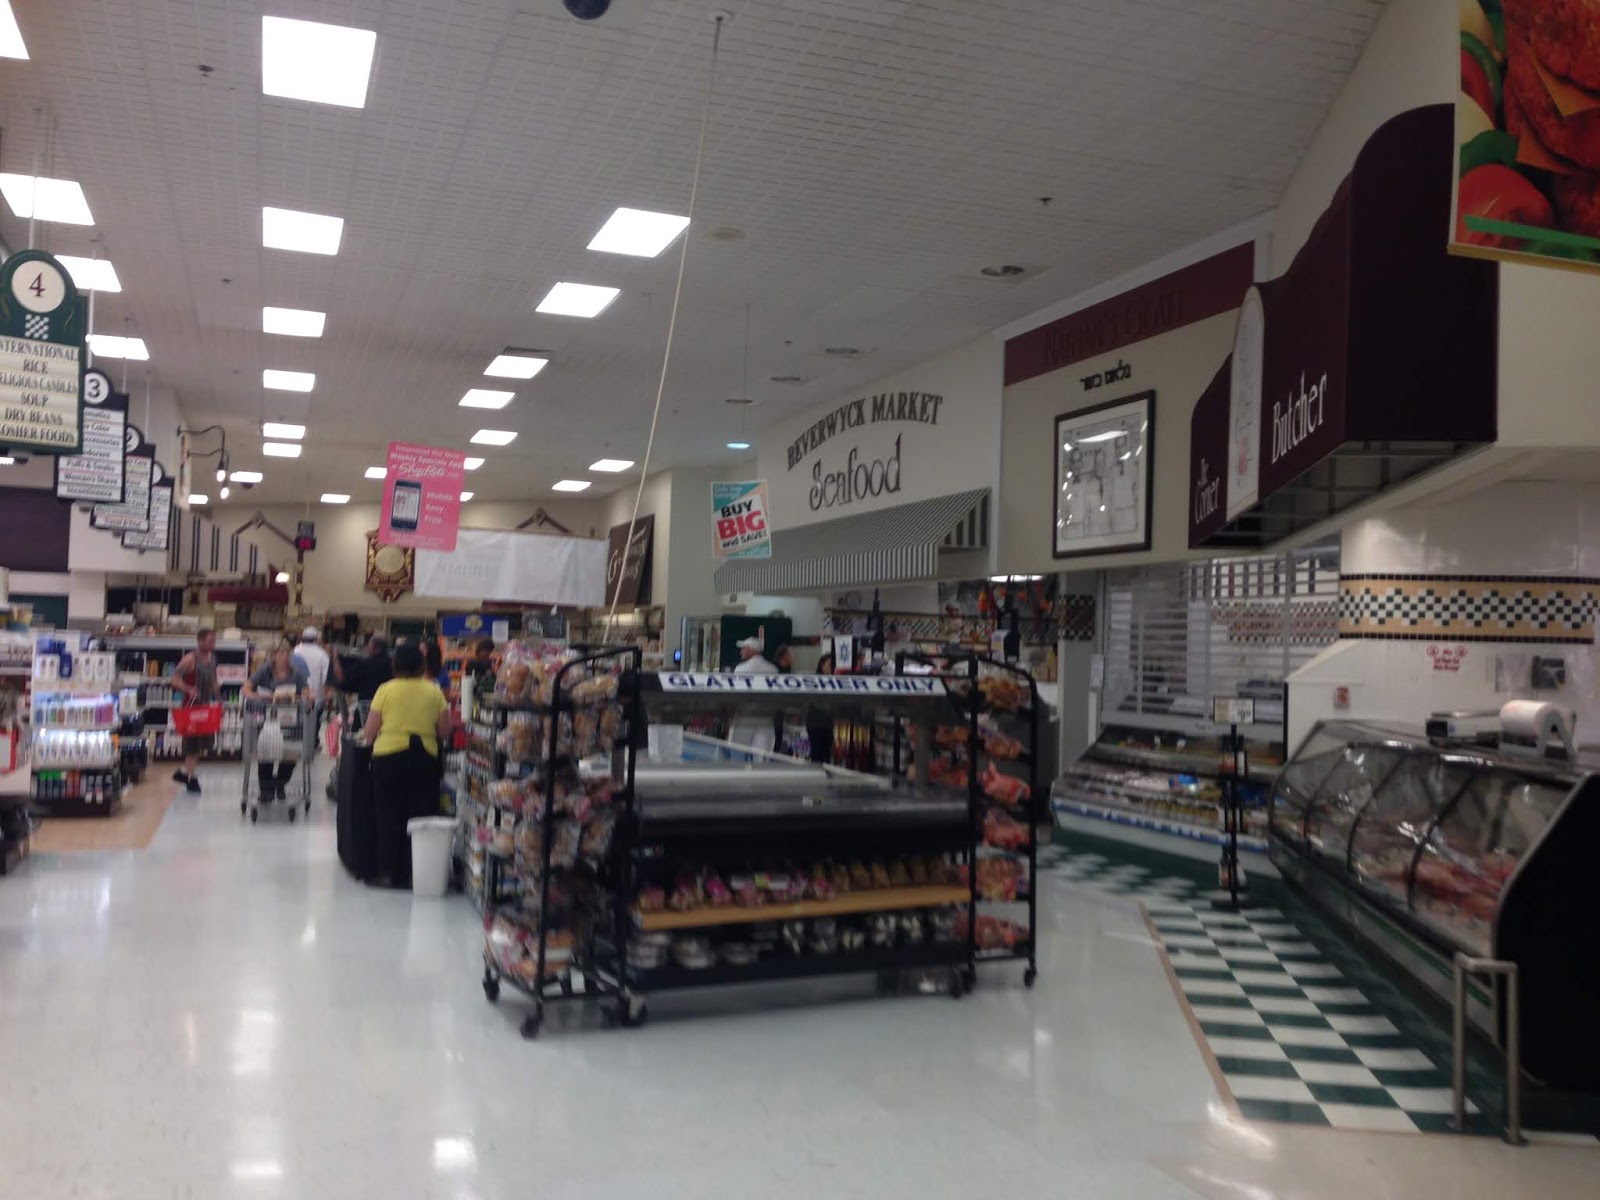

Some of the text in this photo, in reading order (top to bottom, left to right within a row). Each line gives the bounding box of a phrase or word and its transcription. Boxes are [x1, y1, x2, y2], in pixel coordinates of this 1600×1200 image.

[29, 272, 46, 297] 4
[0, 340, 79, 361] NTERNATIONAL
[23, 359, 49, 374] RICE
[89, 379, 101, 398] 3
[21, 391, 48, 407] SOUP
[5, 407, 63, 425] DRY BEANS
[1271, 370, 1327, 464] Butcher
[1, 424, 75, 443] OSHER FOODS
[787, 392, 943, 472] BEVERWYCK MARKET
[809, 432, 902, 511] Seafood
[721, 500, 753, 518] BUY
[717, 510, 766, 540] BIG
[668, 674, 936, 692] GLATT KOSHER ONLY
